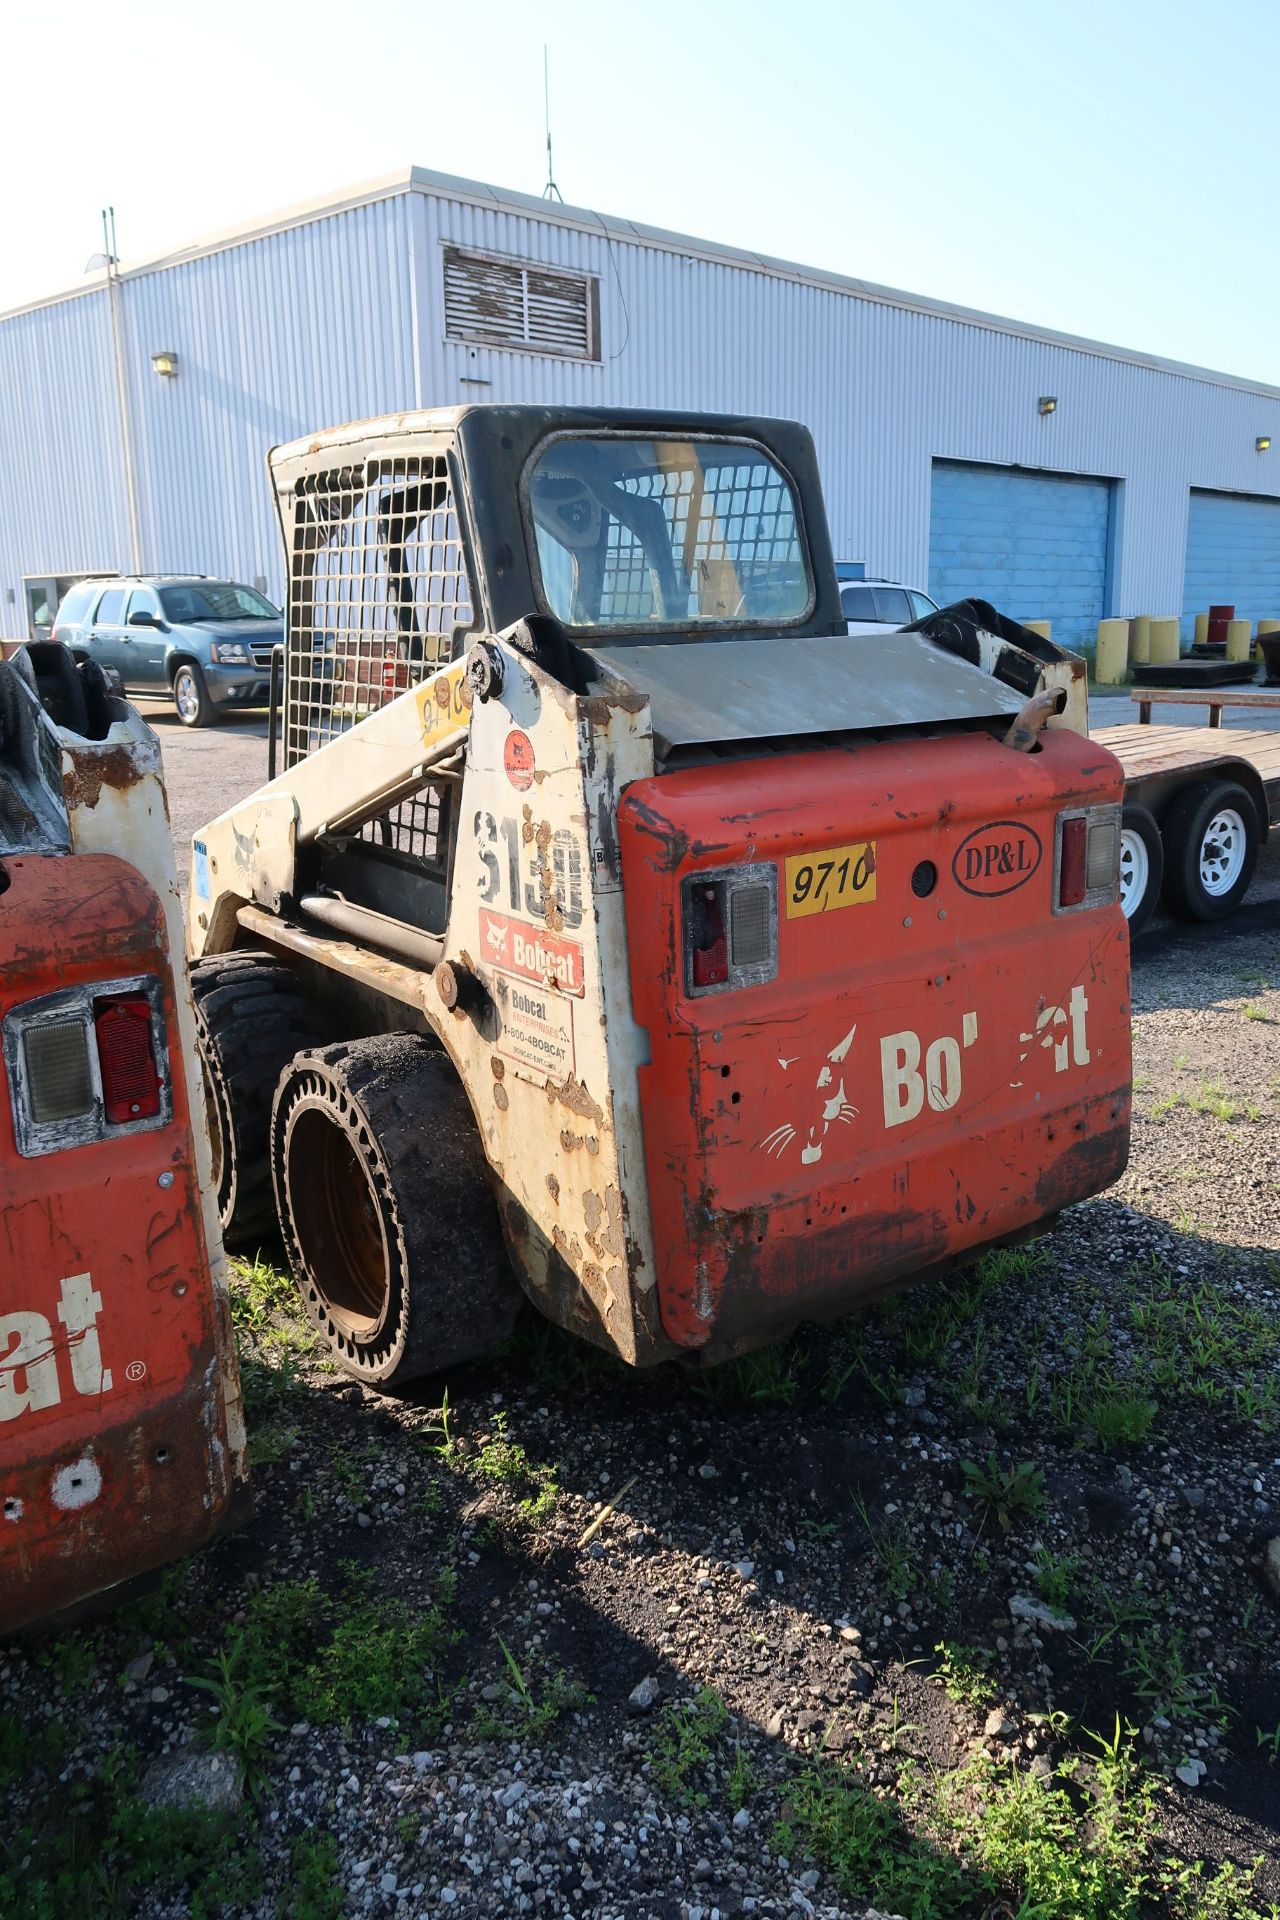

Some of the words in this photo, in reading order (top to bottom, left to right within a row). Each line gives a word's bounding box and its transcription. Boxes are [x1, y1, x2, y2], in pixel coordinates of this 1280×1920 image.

[964, 839, 1032, 881] DP&L
[792, 856, 872, 904] 9710
[511, 989, 547, 1021] Bobcat
[503, 1024, 566, 1060] 1-800-4BOBCAT
[512, 1012, 559, 1039] ENTERPRISES
[879, 984, 1091, 1129] Boat
